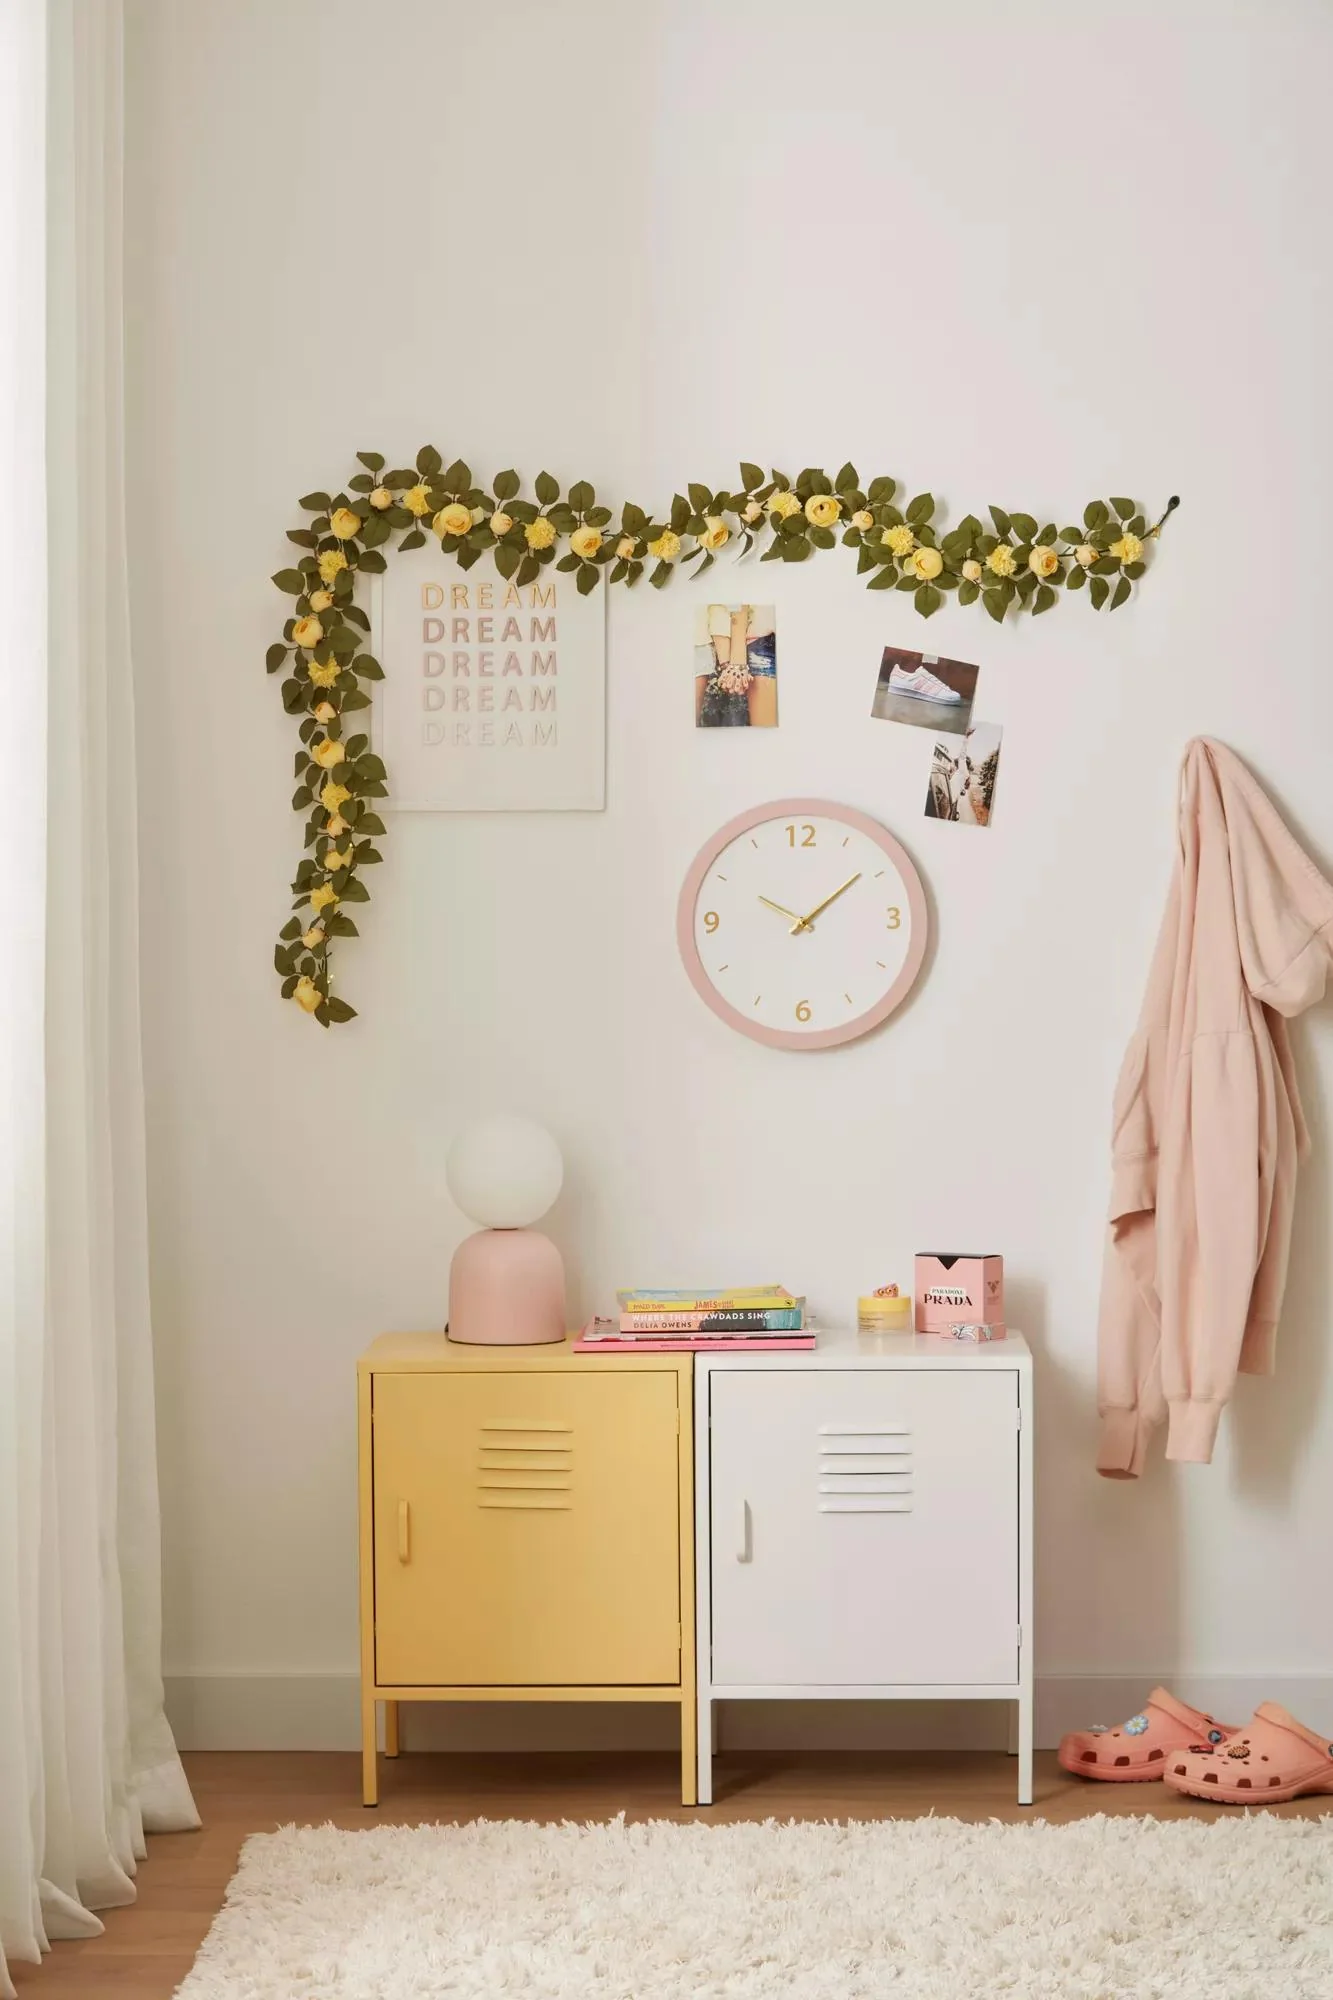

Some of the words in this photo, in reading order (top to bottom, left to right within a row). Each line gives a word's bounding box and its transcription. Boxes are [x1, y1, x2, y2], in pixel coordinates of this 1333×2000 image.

[421, 583, 557, 610] DREAM
[423, 616, 557, 643] DREAM
[423, 650, 557, 678] DREAM
[423, 684, 557, 712] DREAM
[423, 719, 557, 747] DREAM
[785, 824, 817, 848] 12
[704, 911, 720, 934] 9
[886, 906, 901, 930] 3
[795, 1000, 811, 1022] 6
[924, 1293, 973, 1307] PRADA
[661, 1321, 692, 1329] OWENS
[747, 1312, 771, 1320] SING
